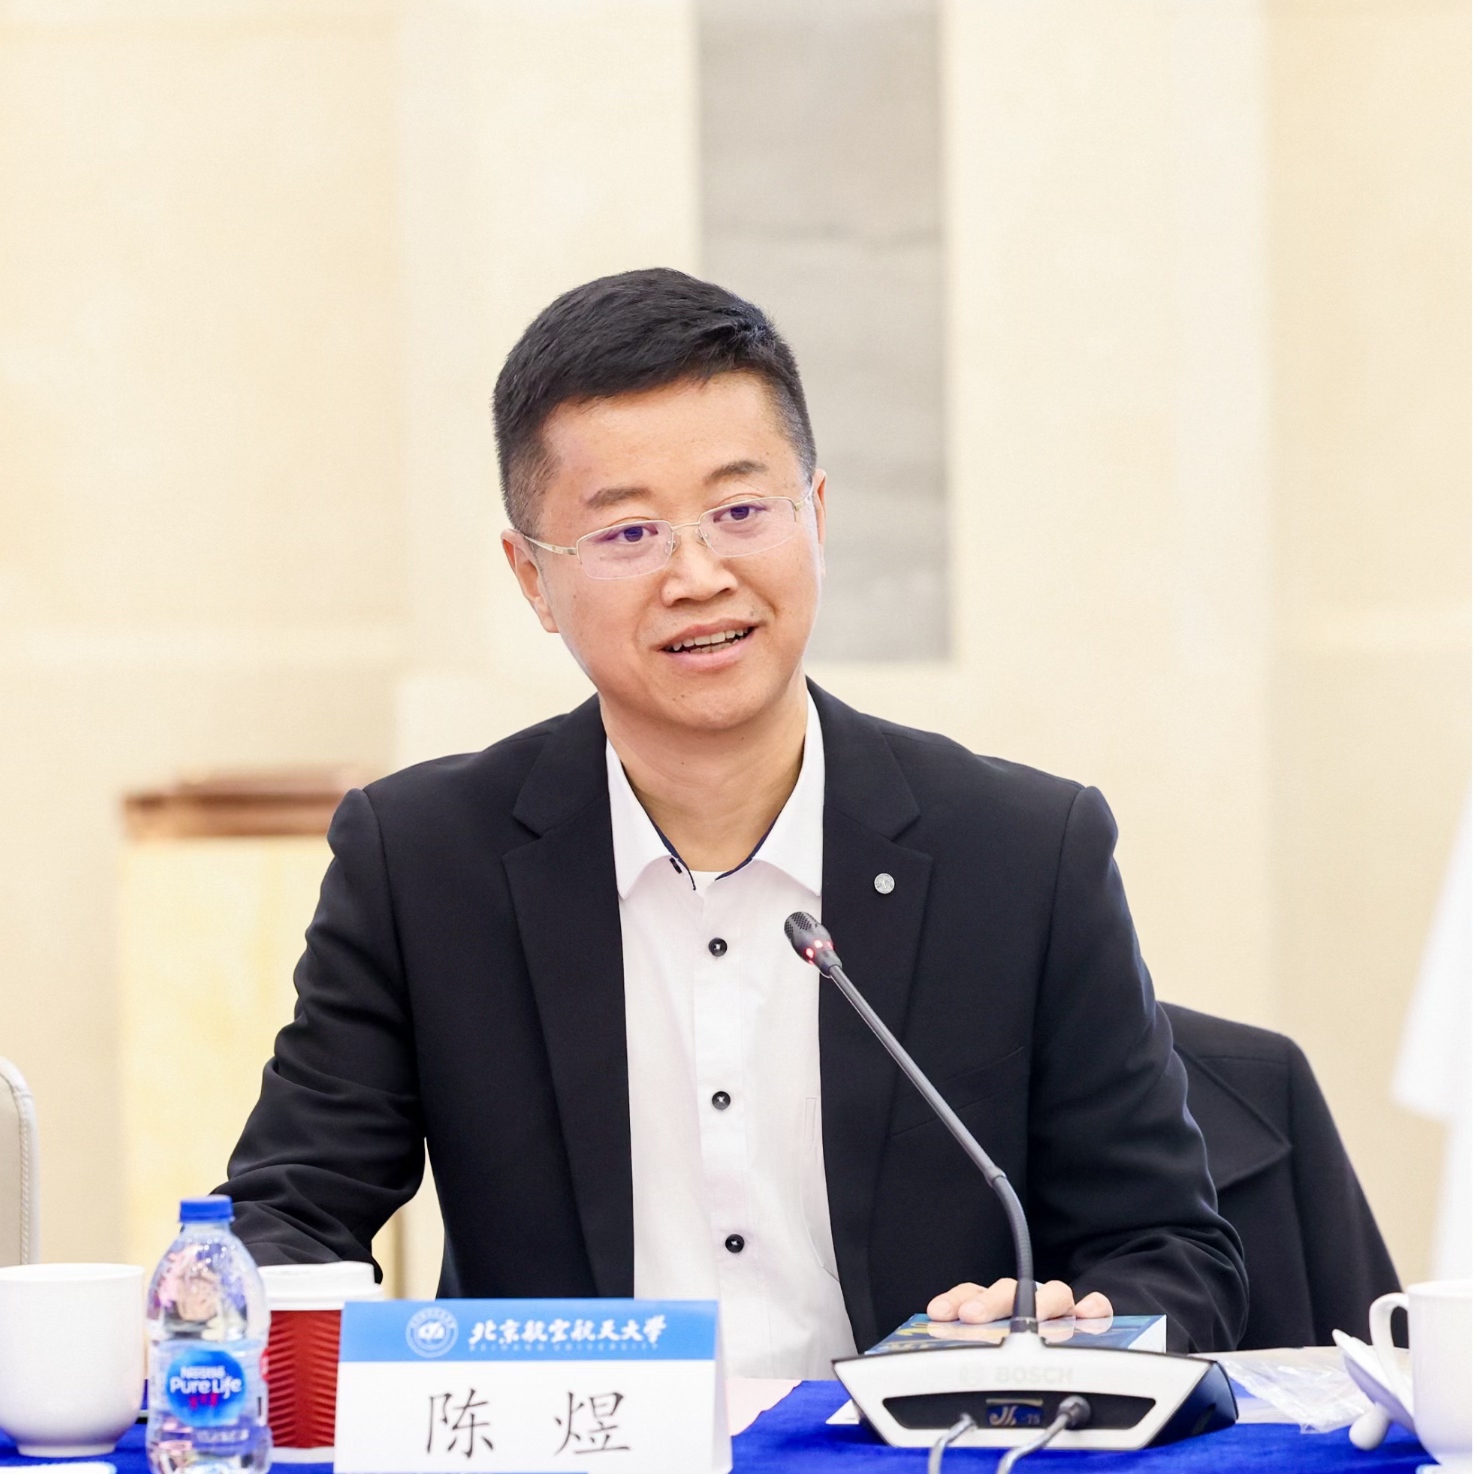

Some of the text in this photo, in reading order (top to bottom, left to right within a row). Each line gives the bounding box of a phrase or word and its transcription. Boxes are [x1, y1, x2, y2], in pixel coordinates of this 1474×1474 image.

[468, 1314, 667, 1344] 北京航空航天大学
[995, 1365, 1074, 1384] BOSCH
[169, 1376, 243, 1400] Pure Life
